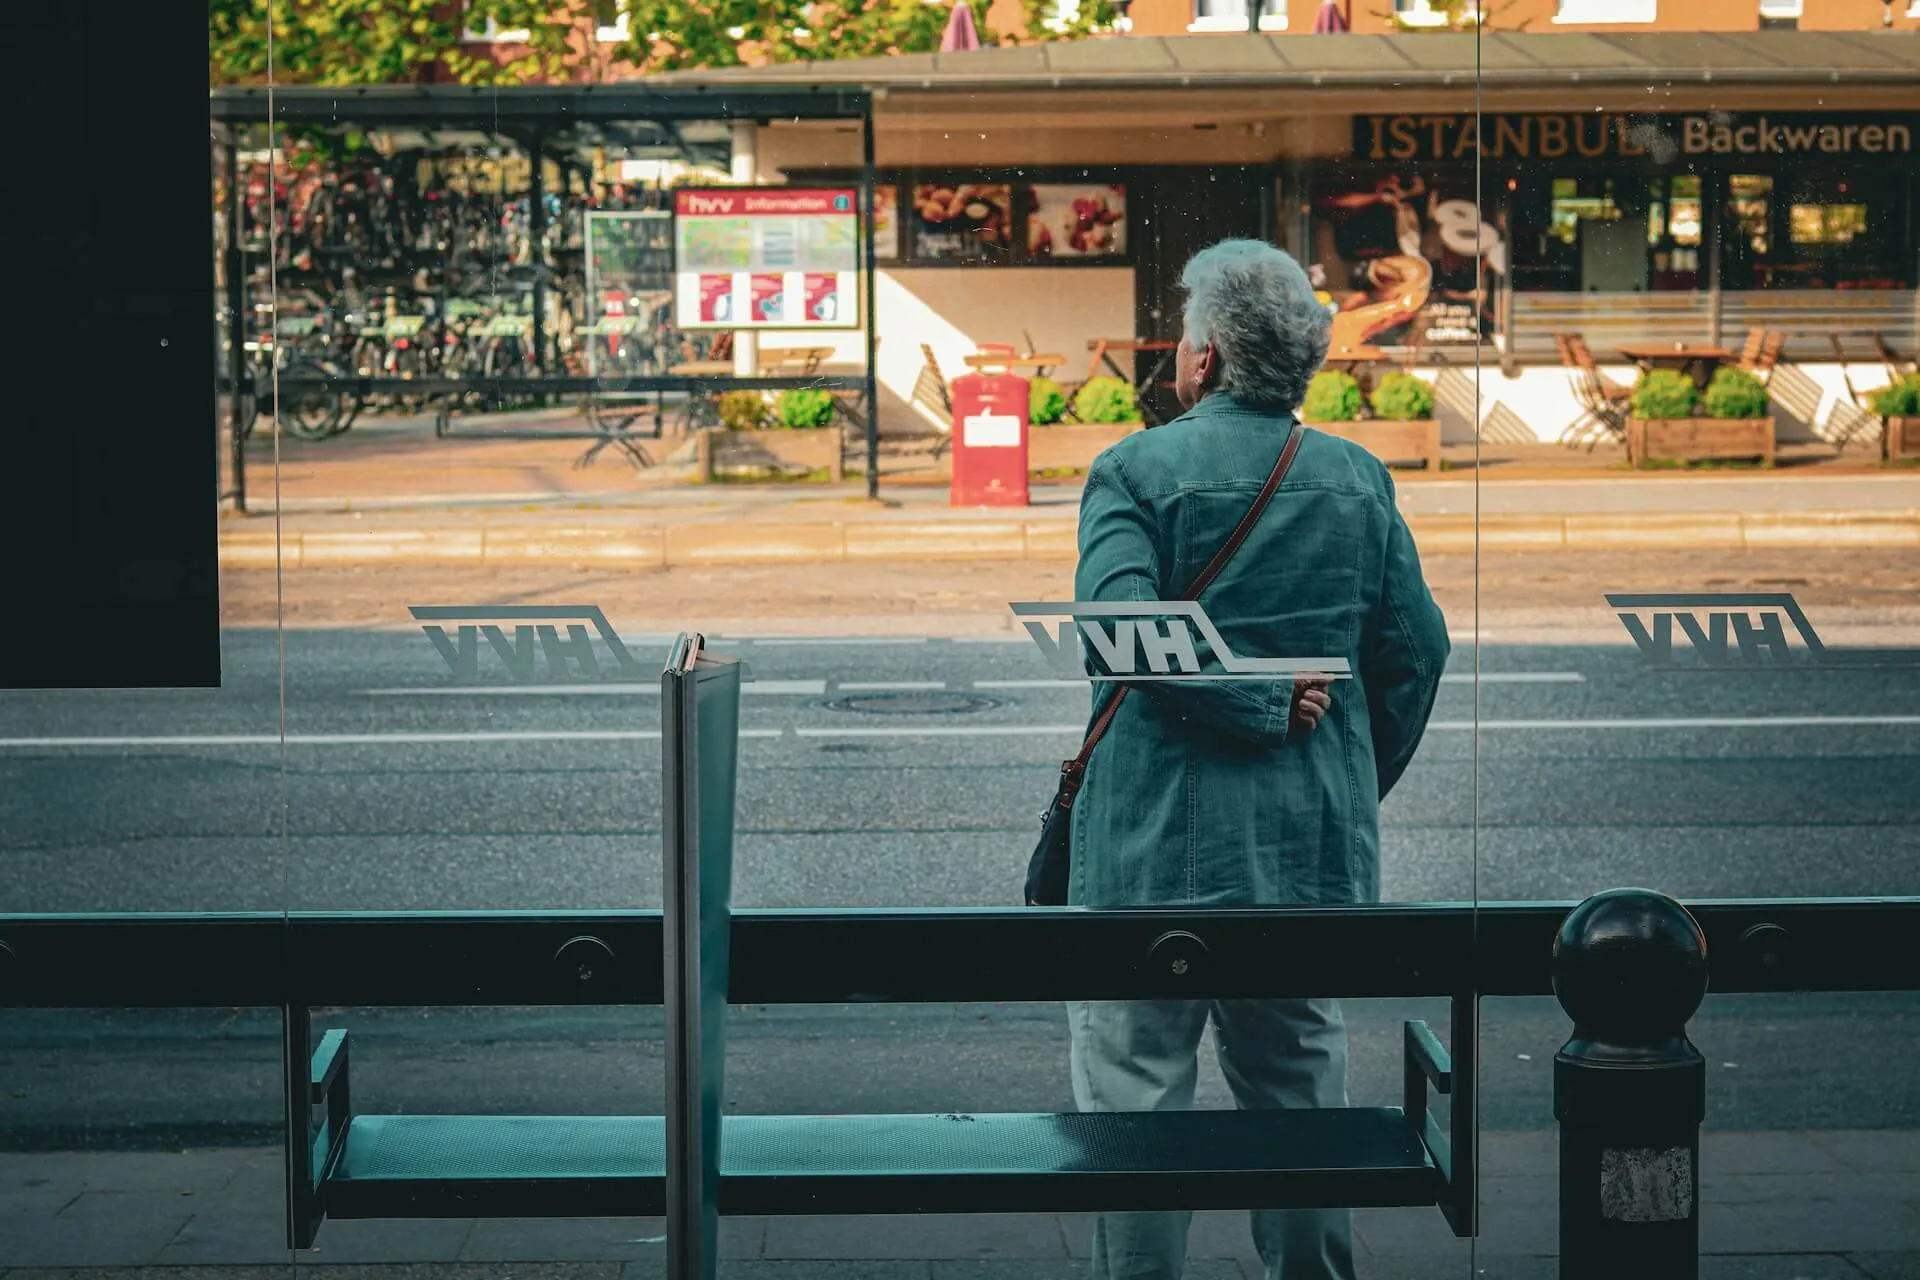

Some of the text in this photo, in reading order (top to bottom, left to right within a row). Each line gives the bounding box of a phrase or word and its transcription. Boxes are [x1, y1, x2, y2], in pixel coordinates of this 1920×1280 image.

[1370, 115, 1912, 160] ISTANBUL Backwaren
[688, 193, 828, 213] hvv Information
